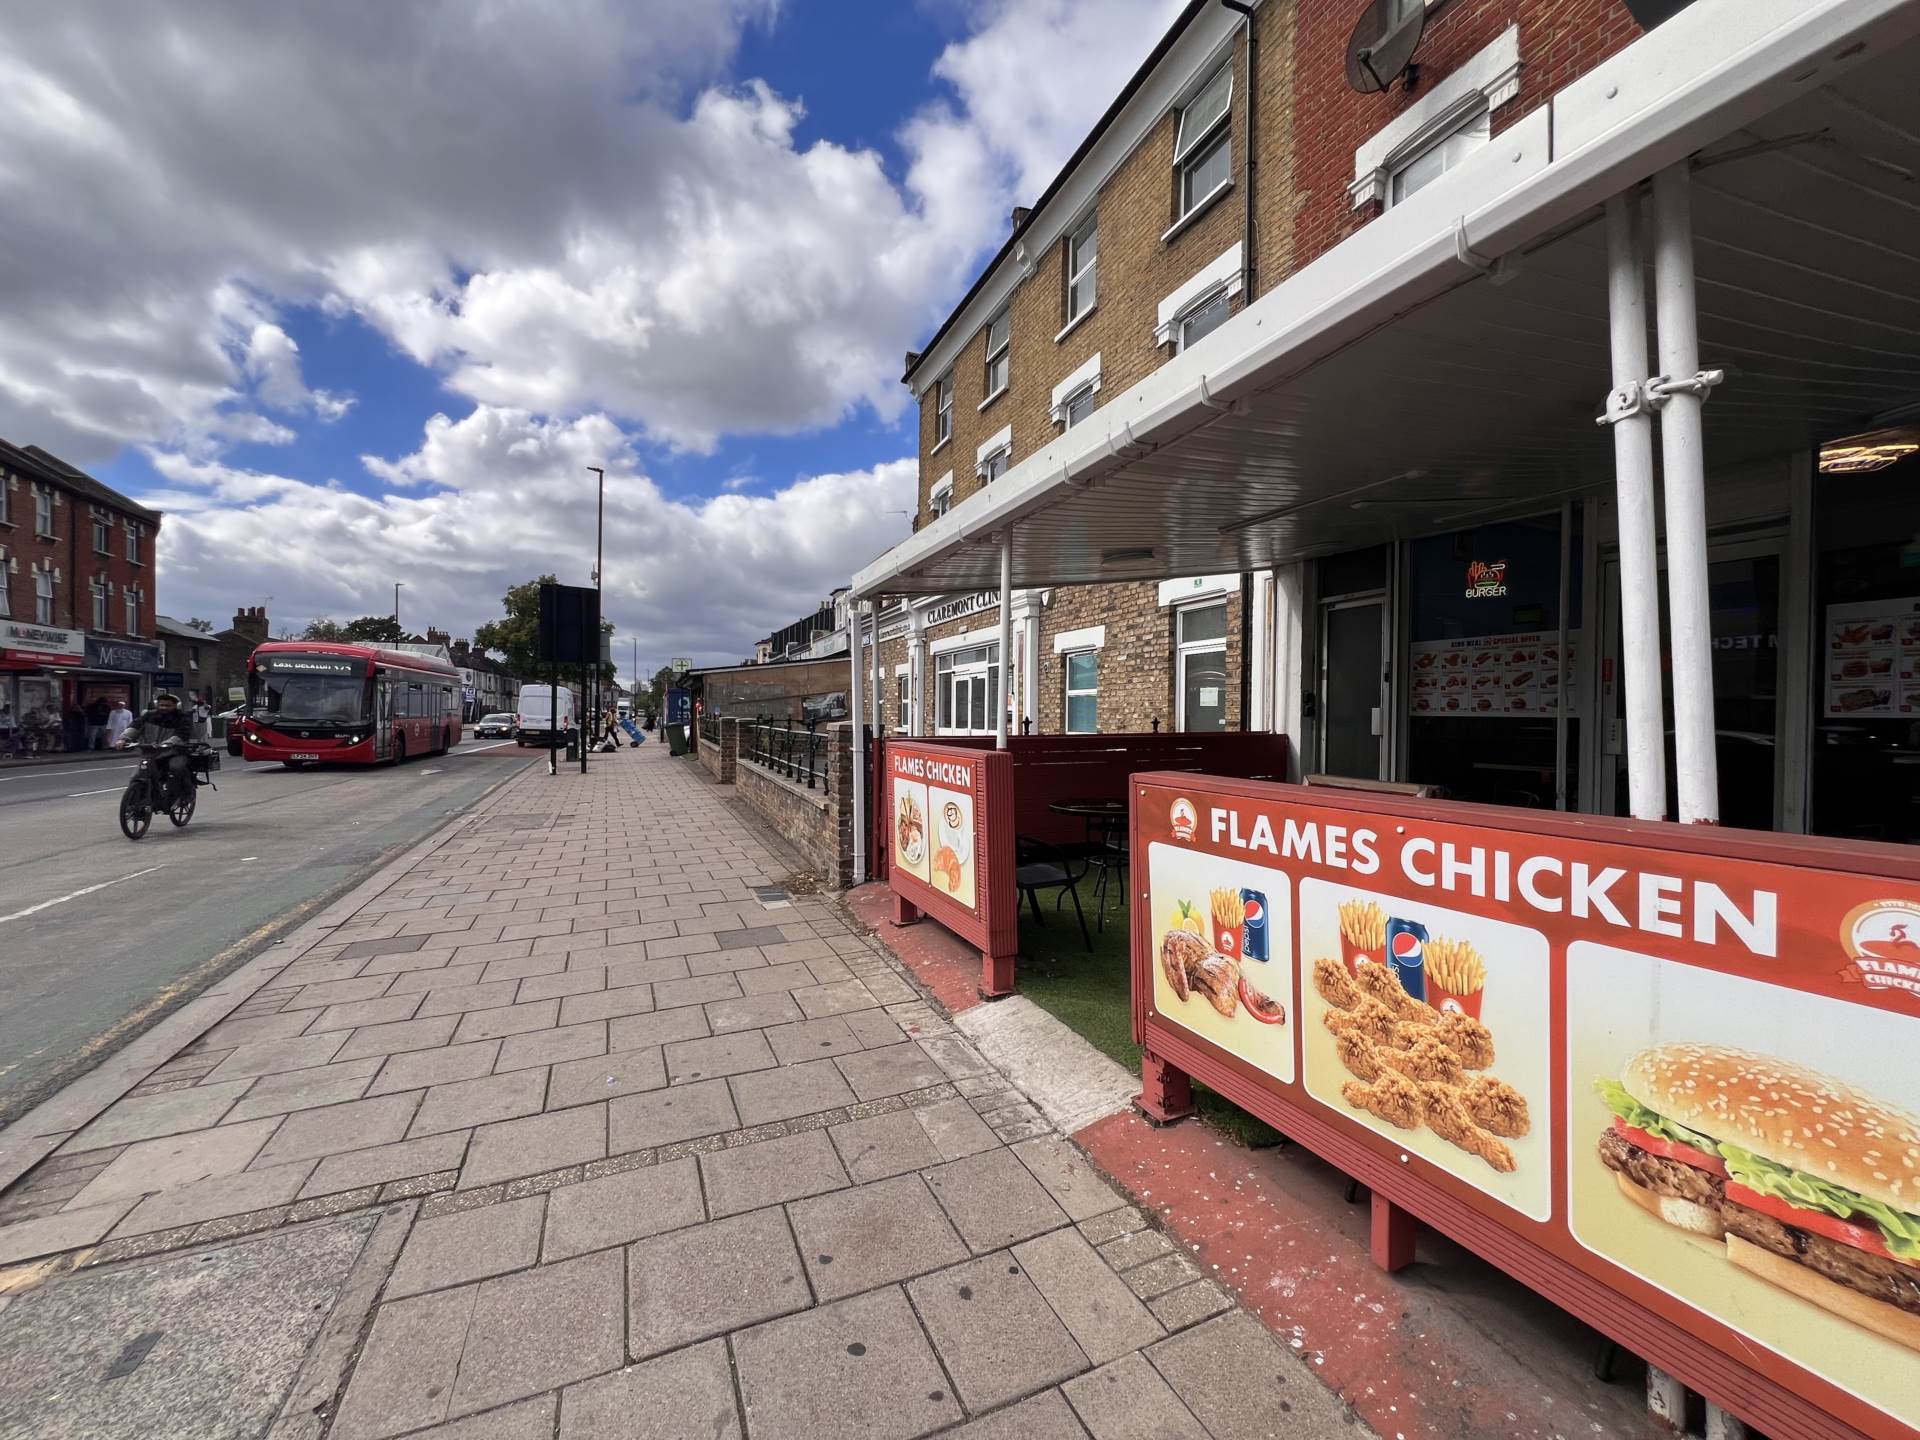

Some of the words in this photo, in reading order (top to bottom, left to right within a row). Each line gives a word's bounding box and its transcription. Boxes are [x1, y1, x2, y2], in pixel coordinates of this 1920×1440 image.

[1465, 586, 1507, 598] BURGER
[927, 596, 975, 624] CLAREMONT
[976, 591, 1001, 608] CLIN
[894, 755, 924, 778] FLAMES
[926, 760, 971, 788] CHICKEN
[1210, 807, 1380, 875] FLAMES
[1400, 837, 1778, 958] CHICKEN
[1243, 925, 1251, 953] pepsi
[1856, 960, 1920, 980] FLAM
